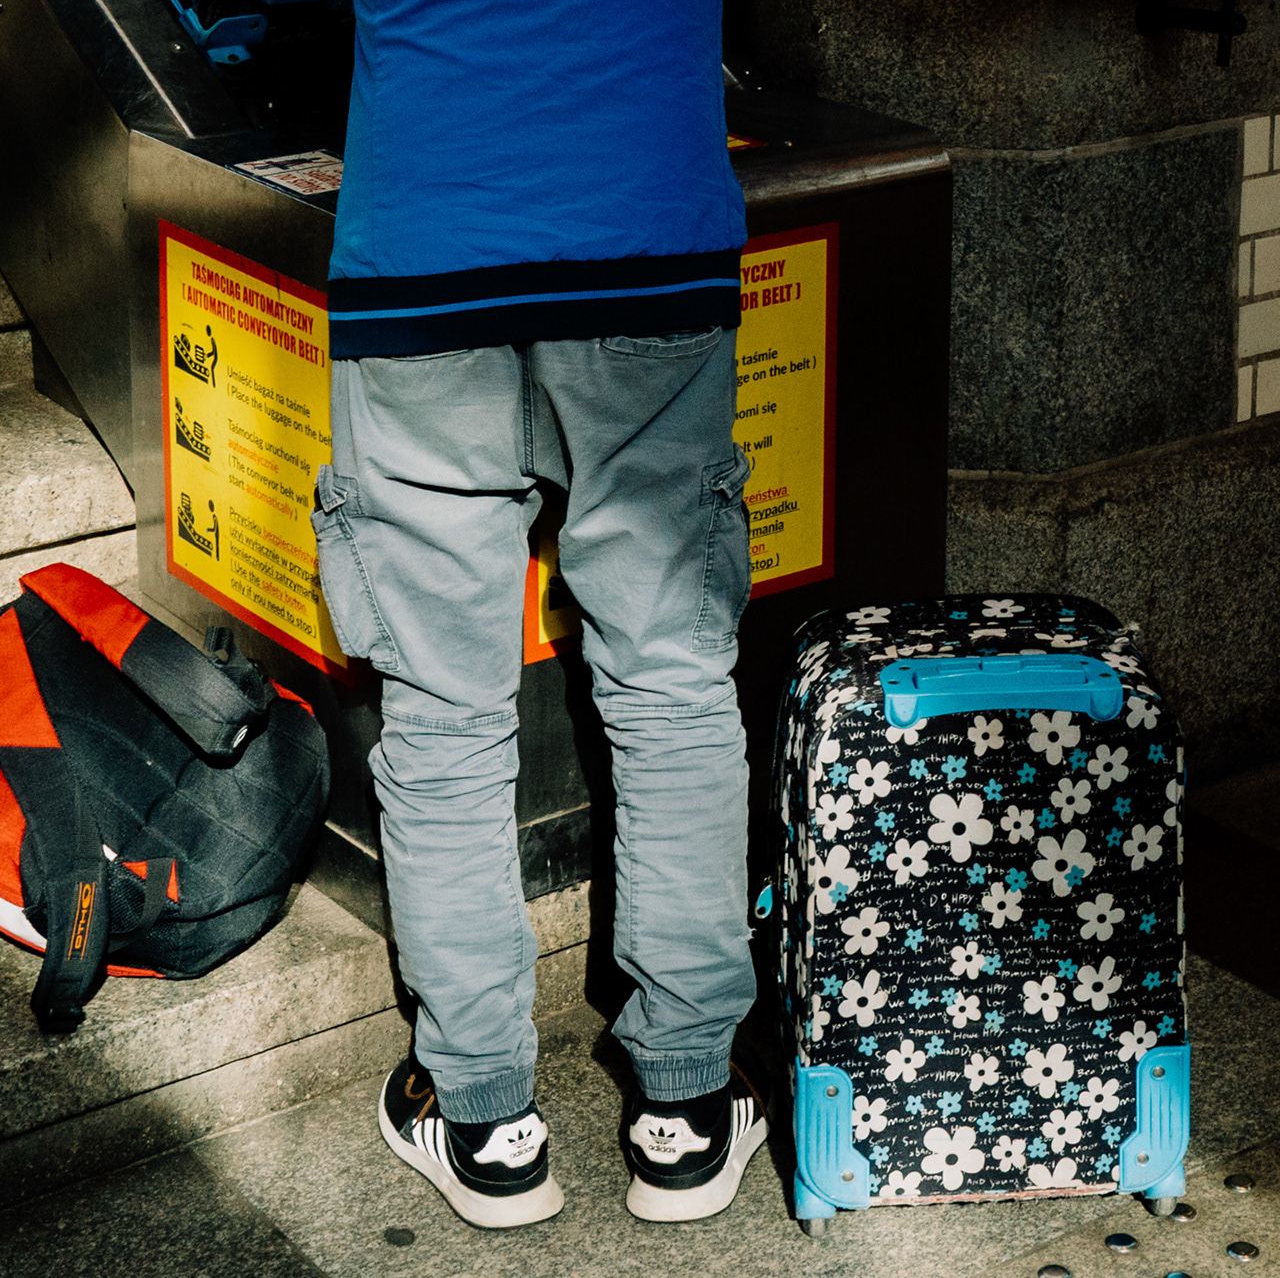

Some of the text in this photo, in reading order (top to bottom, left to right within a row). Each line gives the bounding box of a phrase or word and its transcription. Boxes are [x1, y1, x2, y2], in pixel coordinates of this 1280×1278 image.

[191, 261, 314, 335] TAŚMOCIĄG AUTOMATYCZNY
[762, 284, 793, 307] BELT
[187, 286, 320, 366] AUTOMATIC CONVEYOYOR BELT
[742, 348, 778, 367] taśmie
[752, 370, 766, 381] on
[770, 364, 787, 377] the
[790, 357, 811, 372] belt
[231, 385, 249, 404] Place
[251, 397, 262, 412] the
[264, 402, 292, 428] luggage
[293, 421, 303, 433] on
[305, 424, 317, 440] the
[286, 397, 310, 418] taśmie
[762, 402, 777, 414] się
[754, 435, 772, 451] will
[265, 441, 299, 466] uruchomi
[300, 459, 310, 476] się
[228, 474, 294, 520] start automatically
[246, 467, 279, 490] conveyor
[280, 484, 294, 501] belt
[296, 494, 309, 508] will
[744, 485, 788, 505] zeństwa
[751, 520, 784, 538] mania
[289, 560, 321, 586] przypad
[510, 1145, 535, 1158] adidas
[648, 1144, 677, 1154] adidas
